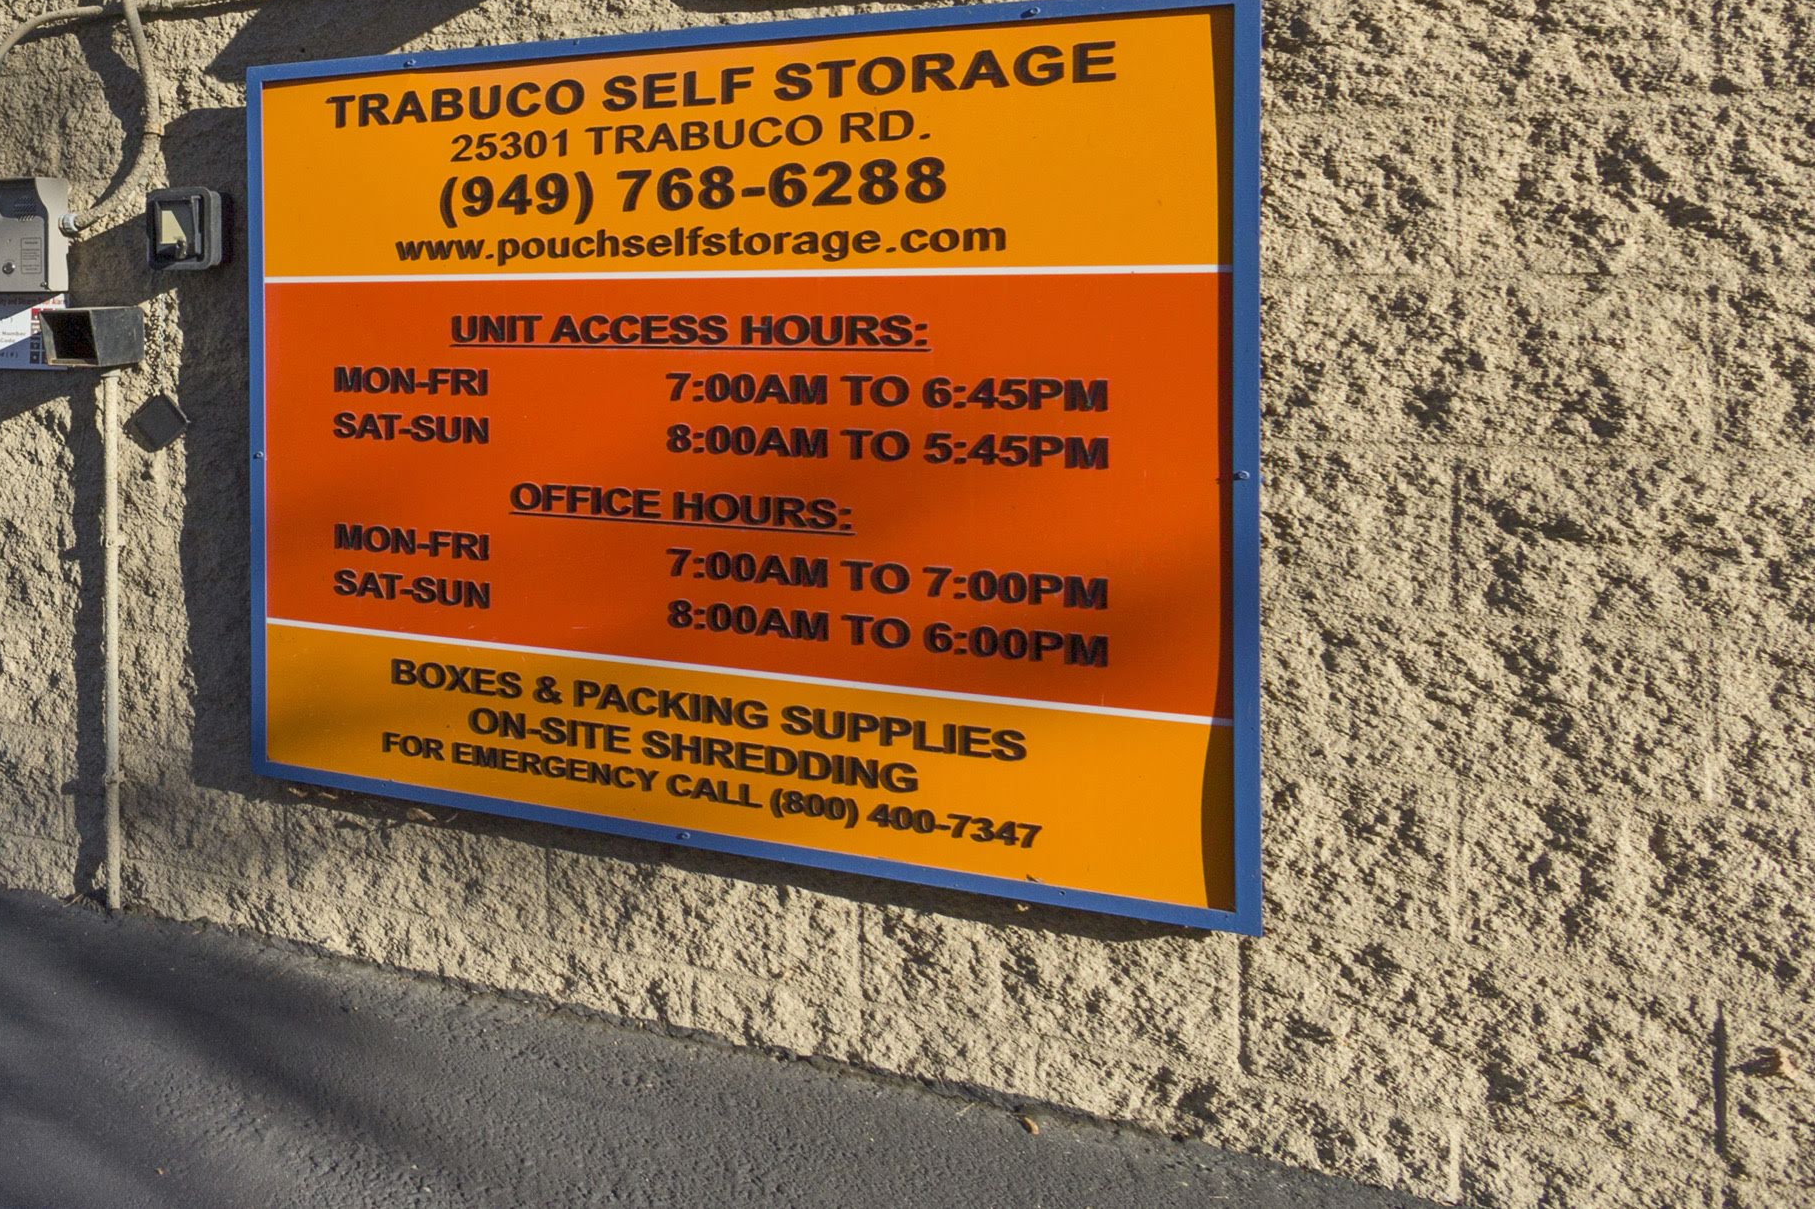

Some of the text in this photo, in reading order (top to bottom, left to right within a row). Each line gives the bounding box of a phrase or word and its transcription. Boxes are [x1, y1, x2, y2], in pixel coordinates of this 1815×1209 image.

[326, 41, 1115, 128] TRABUCO SELF STORAGE
[451, 110, 930, 161] 25301 TRABUCO RD.
[440, 157, 946, 227] (949) 768-6288
[396, 223, 1005, 266] www.pouchselfstorage.com
[452, 315, 930, 350] UNIT ACCESS HOURS:
[335, 367, 488, 395] MON-FRI
[667, 373, 1107, 411] 7:00AM TO 6:45PM
[334, 413, 488, 444] SAT-SUN
[667, 425, 1108, 469] 8:00AM TO 5:45PM
[511, 483, 854, 535] OFFICE HOURS:
[335, 524, 489, 561] MON-FRI
[334, 570, 490, 609] SAT-SUN
[667, 549, 1108, 610] 7:00AM TO 7:00PM
[668, 600, 1108, 667] 8:00AM TO 6:00PM
[392, 659, 1026, 762] BOXES & PACKING SUPPLIES
[469, 707, 920, 794] ON-SITE SHREDDING
[383, 732, 1042, 848] FOR EMERGENCY CALL (800) 400-7347
